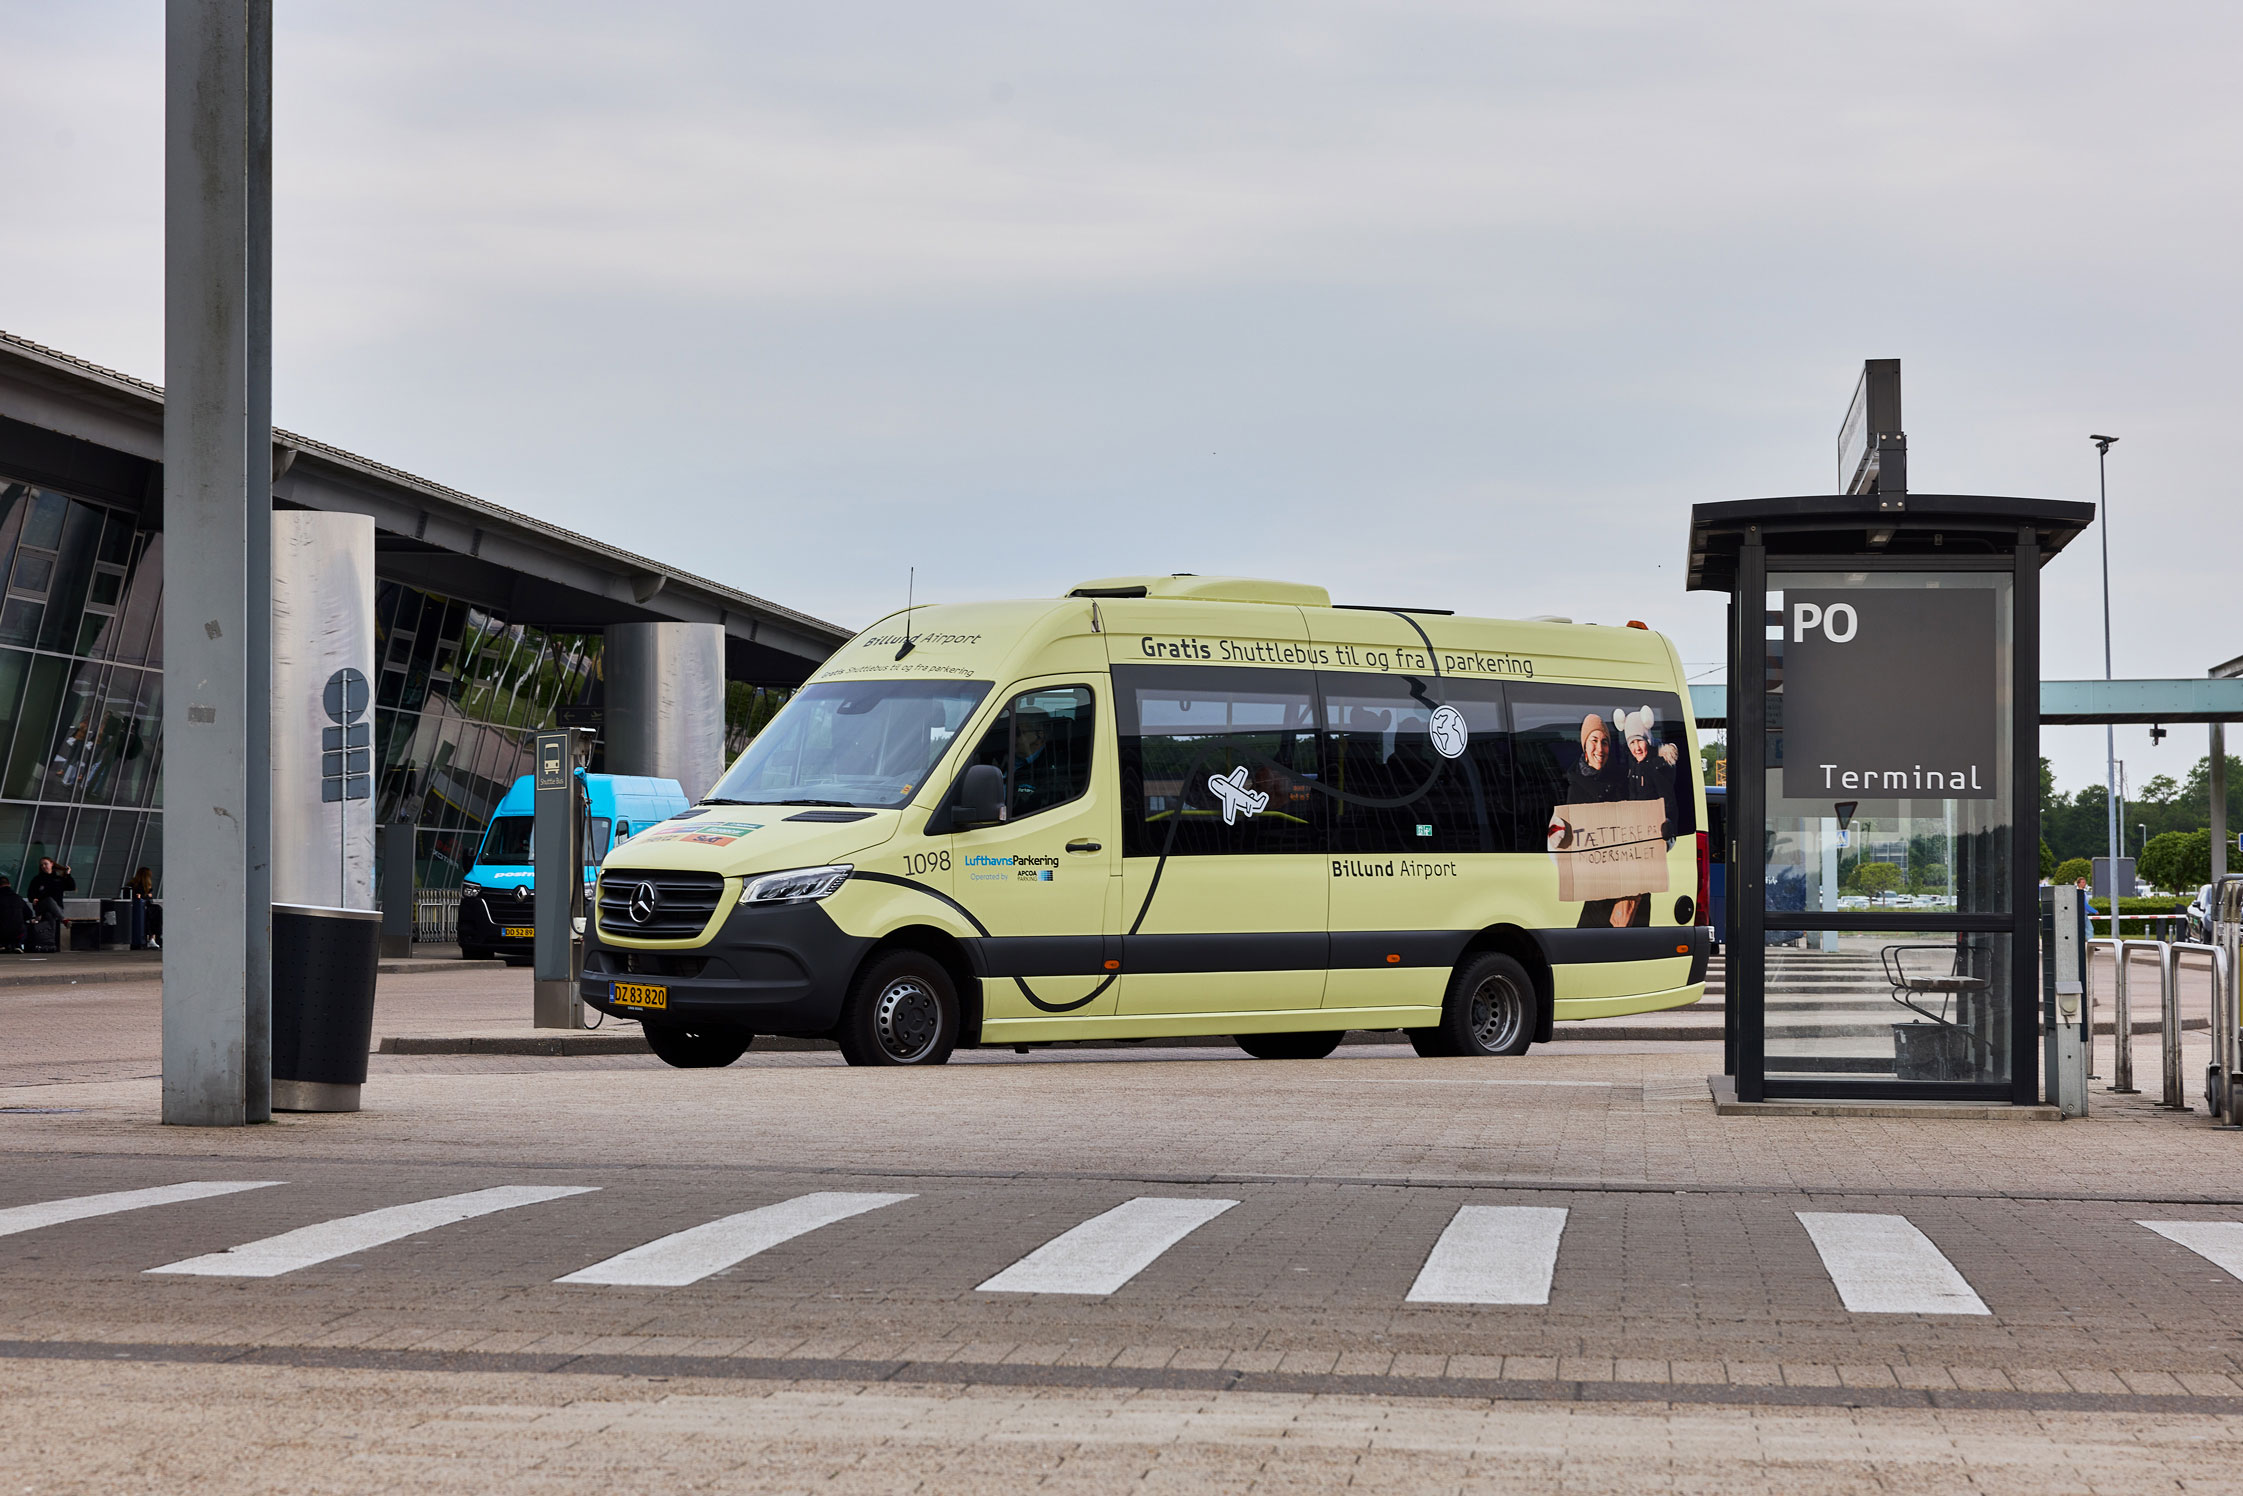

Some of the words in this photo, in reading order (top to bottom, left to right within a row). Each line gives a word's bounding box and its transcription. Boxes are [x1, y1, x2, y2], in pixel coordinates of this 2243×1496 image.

[863, 633, 922, 648] Billund
[920, 632, 982, 645] Airport
[1141, 636, 1211, 659] Gratis
[1219, 640, 1329, 664] Shuttlebus
[1336, 645, 1359, 665] til
[1366, 651, 1389, 671] og
[1396, 648, 1425, 668] fra
[1445, 652, 1534, 678] parkering
[901, 665, 913, 673] og
[914, 664, 929, 672] fra
[929, 665, 974, 678] parkering
[555, 777, 564, 785] Bus
[1819, 764, 1982, 790] Terminal
[1573, 825, 1643, 847] TÆTTERE
[903, 850, 951, 876] 1098
[965, 854, 1059, 868] LufthavnsParkering
[1332, 860, 1394, 877] Billund
[1400, 860, 1457, 880] Airport
[970, 873, 999, 881] Operated
[1000, 873, 1008, 881] by
[615, 986, 628, 1002] DZ
[630, 987, 642, 1003] 83
[645, 988, 665, 1005] 820
